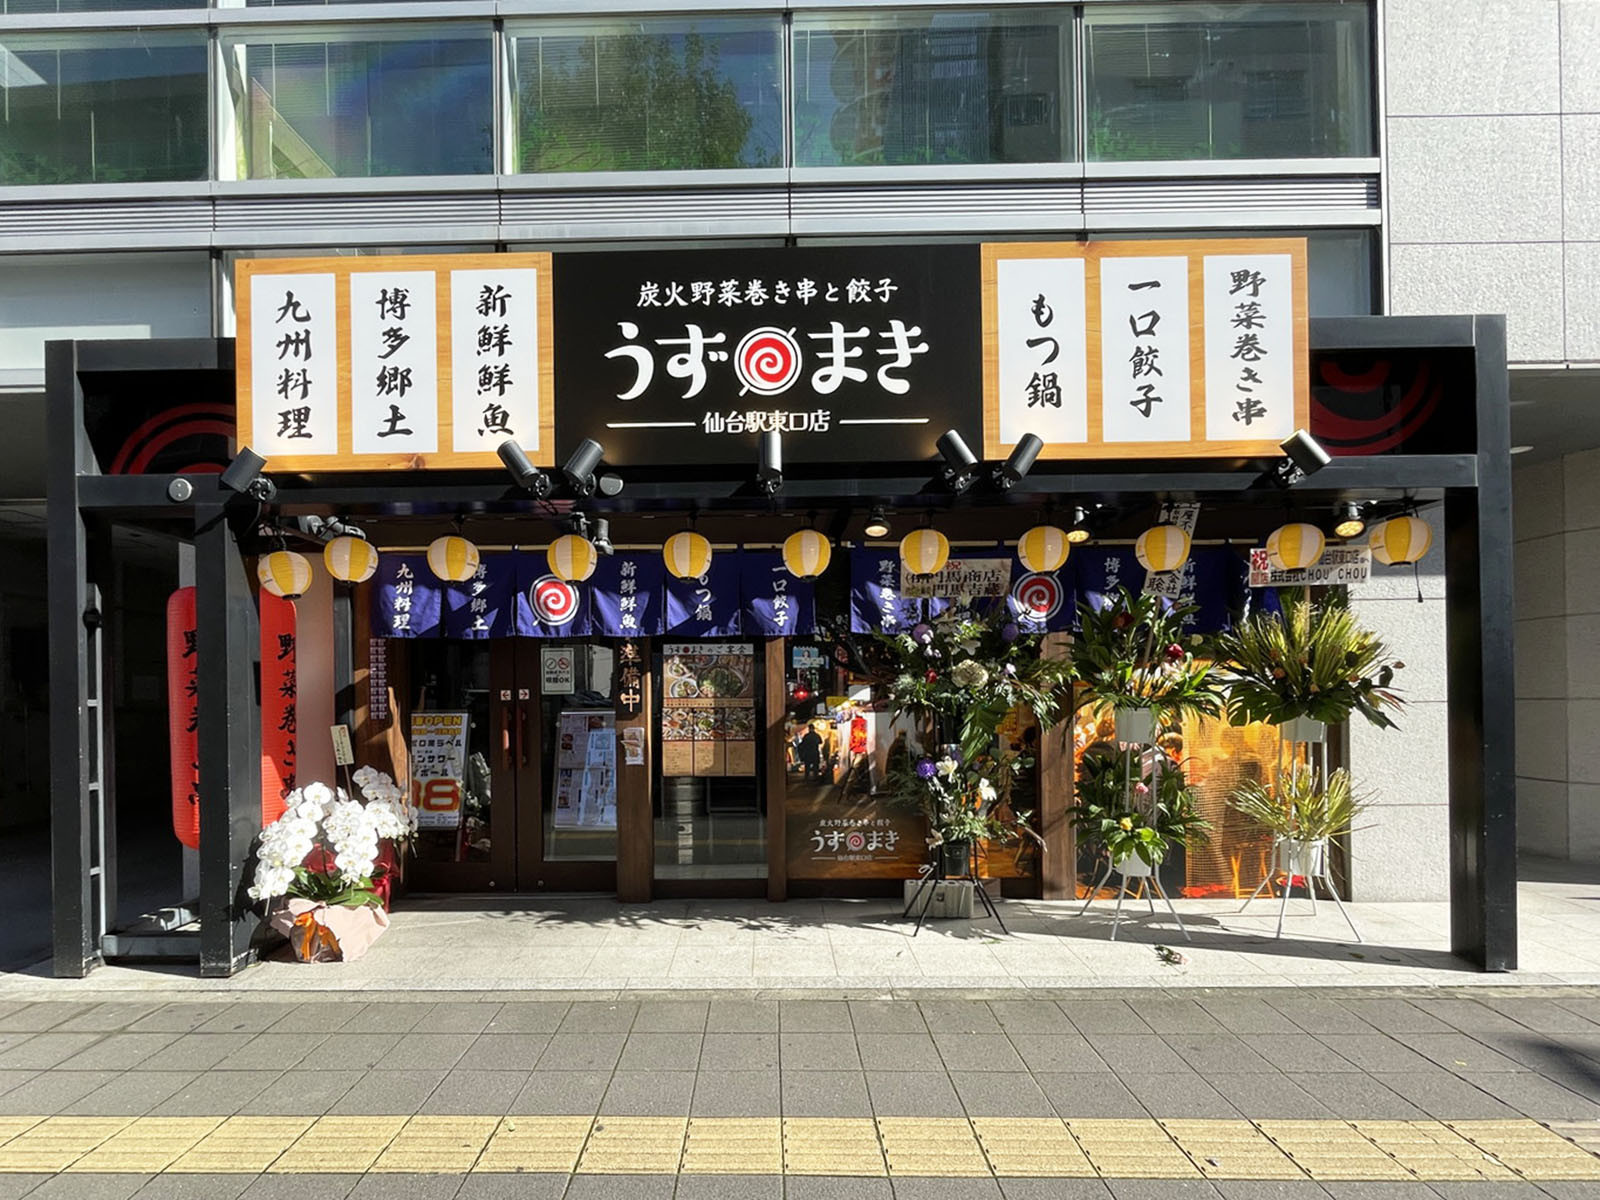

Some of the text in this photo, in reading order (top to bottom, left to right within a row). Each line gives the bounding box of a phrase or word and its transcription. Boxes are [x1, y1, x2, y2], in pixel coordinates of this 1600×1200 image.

[636, 277, 899, 308] 炭火野菜巻き串と餃子
[275, 290, 313, 439] 九州料理
[375, 287, 413, 438] 博多郷土
[475, 284, 514, 437] 新鮮鮮魚
[1024, 293, 1062, 409] もつ鍋
[1127, 279, 1164, 418] 一口餃子
[1228, 268, 1268, 426] 野菜巻き串
[702, 409, 831, 433] 仙台駅東口店
[619, 561, 637, 630] 新鮮鮮魚
[878, 559, 897, 629] 野菜巻き串
[1252, 550, 1269, 571] 祝
[392, 563, 415, 631] 九州料理
[772, 565, 790, 627] 一口餃子
